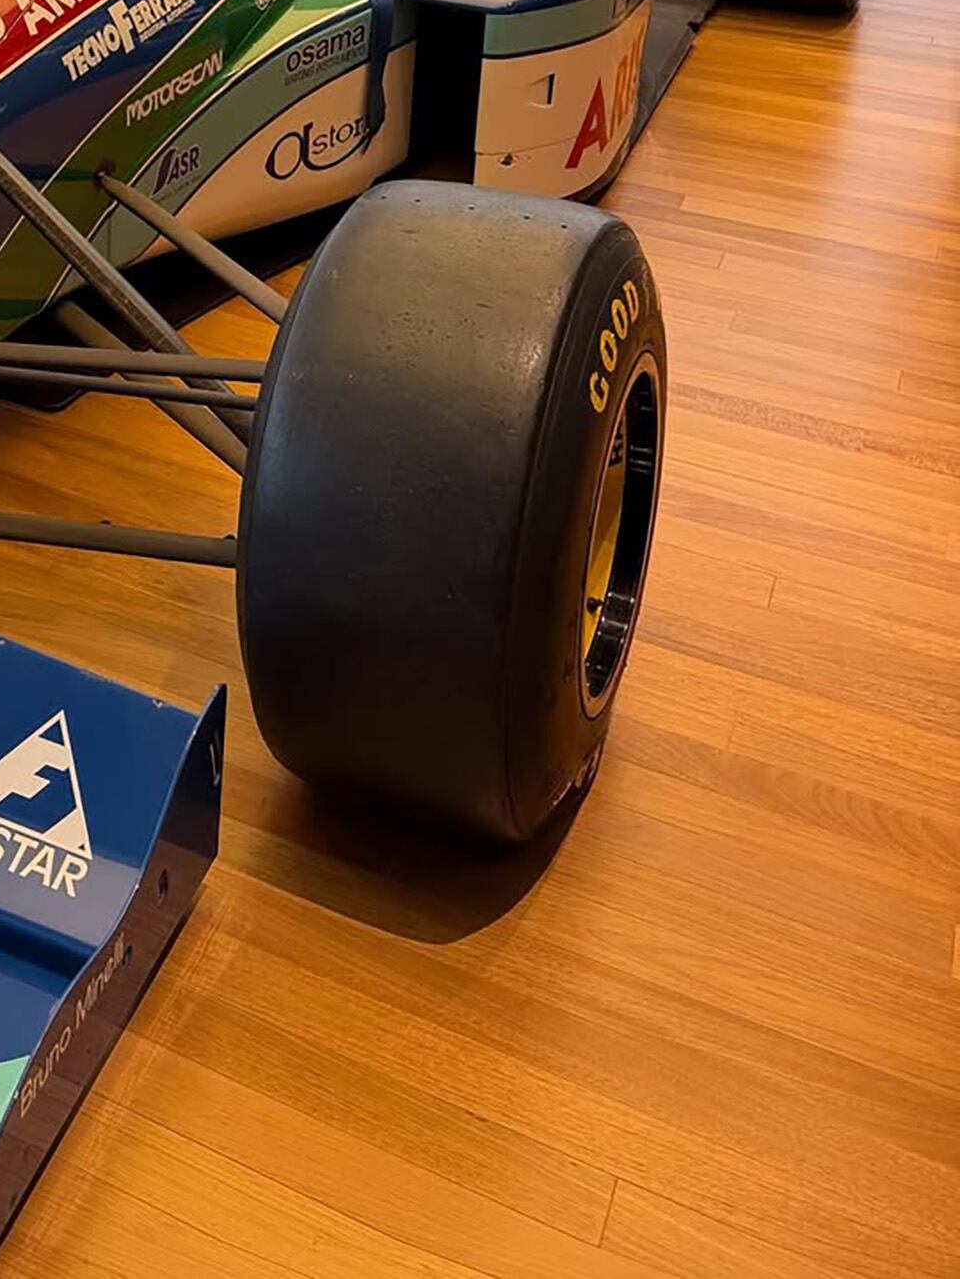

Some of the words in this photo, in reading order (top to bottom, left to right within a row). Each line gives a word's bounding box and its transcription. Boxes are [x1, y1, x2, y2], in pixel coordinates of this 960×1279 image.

[285, 23, 366, 73] osama
[125, 48, 225, 128] MOTORSCAN
[165, 144, 201, 188] ASR
[19, 1026, 72, 1118] Bruno
